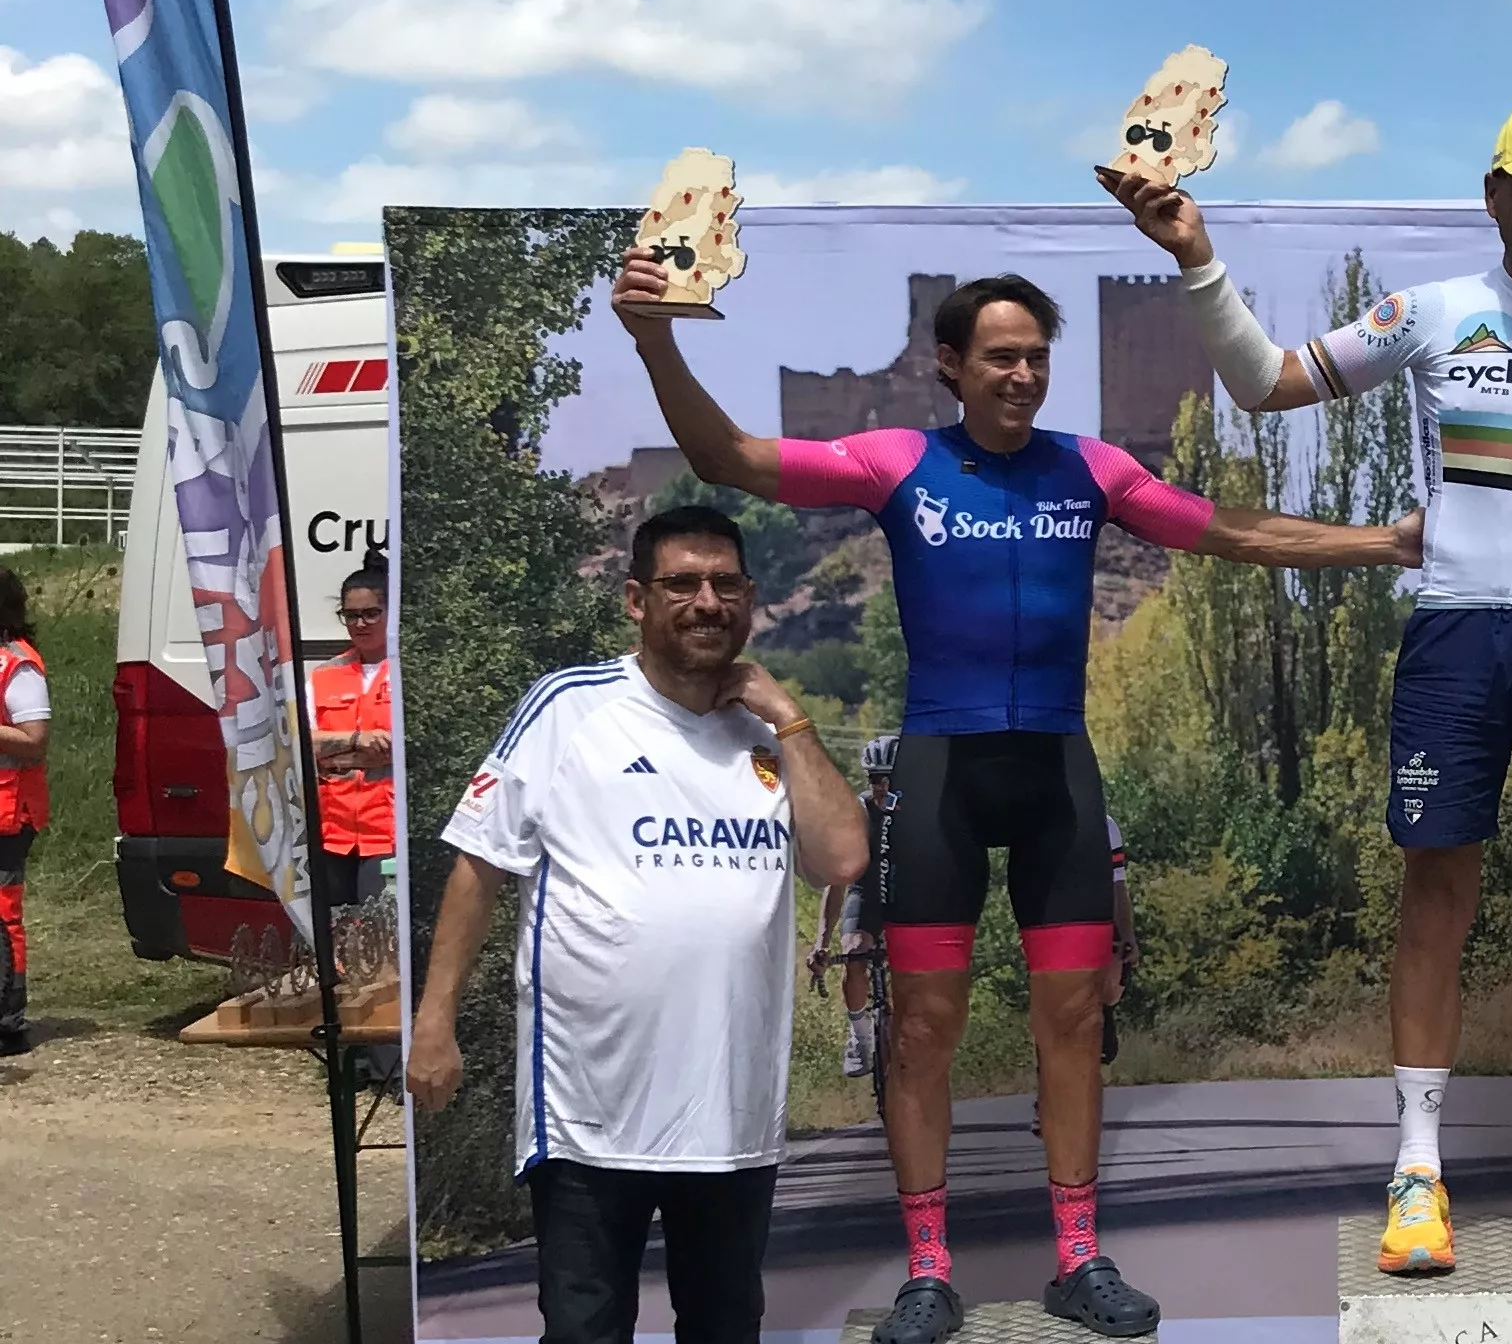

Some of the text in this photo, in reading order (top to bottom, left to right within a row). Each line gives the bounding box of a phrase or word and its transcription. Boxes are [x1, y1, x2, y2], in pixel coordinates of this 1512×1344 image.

[1036, 498, 1091, 512] Bike Team
[308, 510, 390, 553] Cru
[952, 511, 1093, 540] Sock Data
[632, 815, 791, 851] CARAVAN
[635, 854, 787, 872] FRAGANCIA
